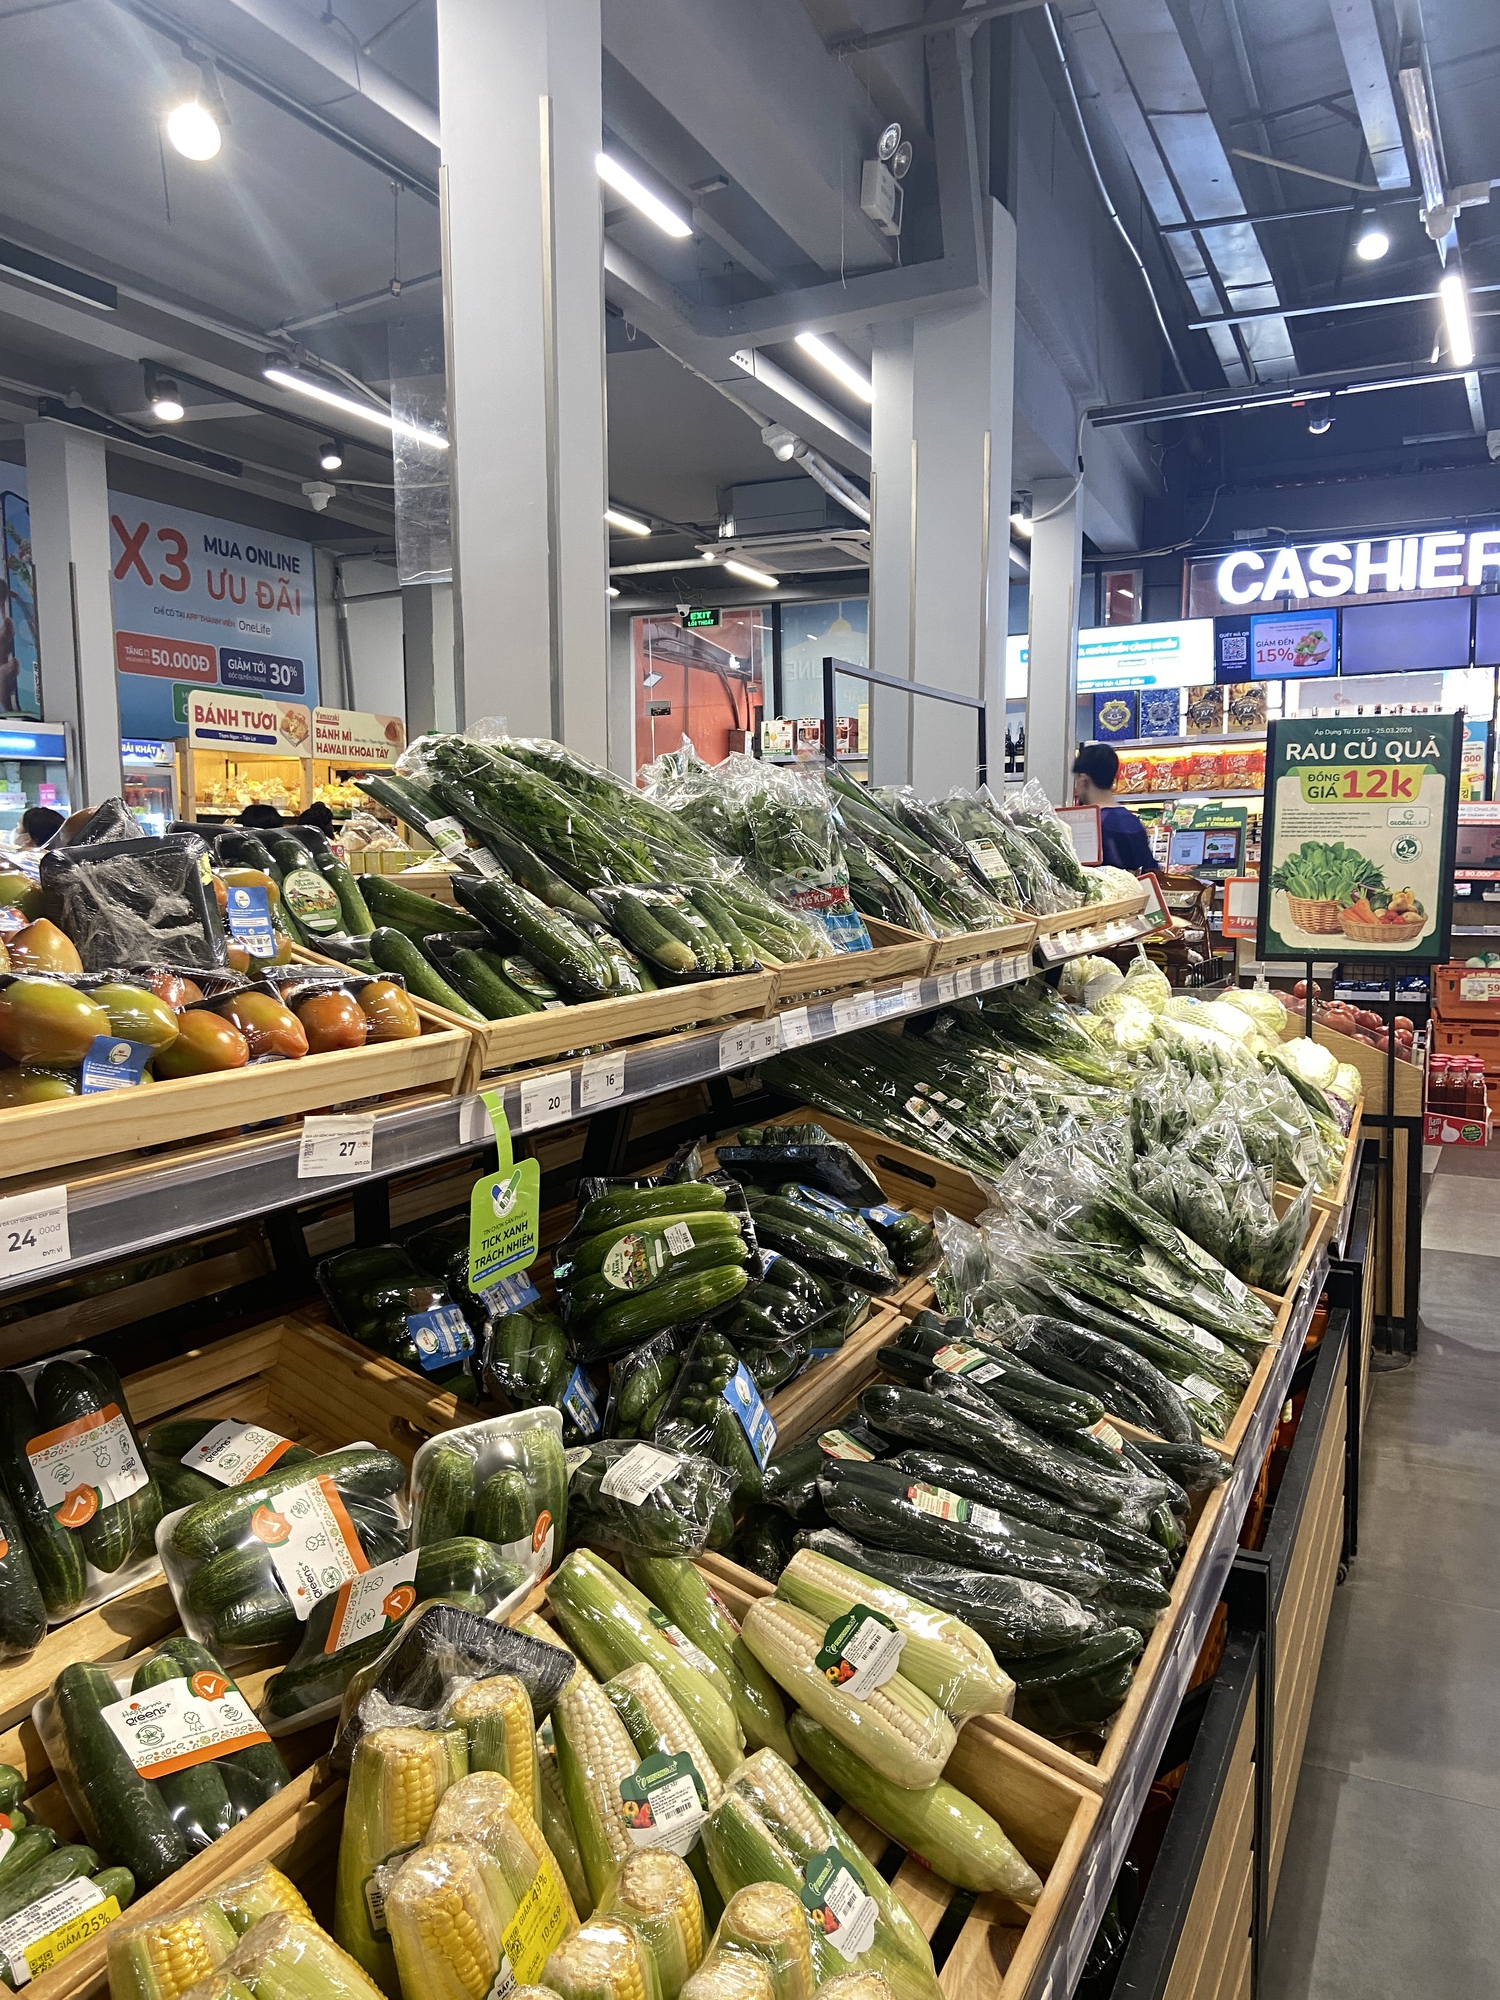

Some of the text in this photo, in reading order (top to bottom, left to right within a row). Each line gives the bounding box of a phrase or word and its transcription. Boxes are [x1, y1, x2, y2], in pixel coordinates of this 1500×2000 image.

[111, 514, 191, 592] X3
[204, 535, 301, 574] MUA ONLINE
[207, 567, 301, 617] ƯU ĐÃI
[690, 610, 711, 620] EXIT
[238, 620, 272, 636] OneLife
[1256, 638, 1276, 648] GIẢM
[1256, 647, 1294, 663] 15%
[151, 648, 210, 672] 50.000Đ
[227, 657, 298, 686] GIẢM TỚI 30%
[194, 702, 239, 727] BÁNH
[242, 711, 278, 731] TƯƠI
[315, 726, 352, 742] BÁNH MÌ
[1314, 728, 1324, 736] Áp
[1375, 726, 1413, 734] 25.03.2026
[135, 743, 156, 755] KHÁT
[316, 742, 347, 756] HAWAII
[348, 745, 375, 758] KHOAI
[1286, 735, 1441, 763] RAU CỦ QUẢ
[1307, 782, 1338, 799] GIÁ
[1342, 769, 1413, 798] 12k
[736, 1040, 743, 1051] 19
[605, 1074, 615, 1087] 16
[548, 1096, 560, 1111] 20
[339, 1141, 356, 1157] 27
[7, 1228, 37, 1252] 24
[481, 1220, 529, 1251] TICK XANH
[474, 1232, 534, 1270] TRÁCH NHIỆM
[531, 1873, 548, 1902] 49%
[56, 1912, 111, 1952] GIẢM 25%
[540, 1905, 561, 1943] 10.659
